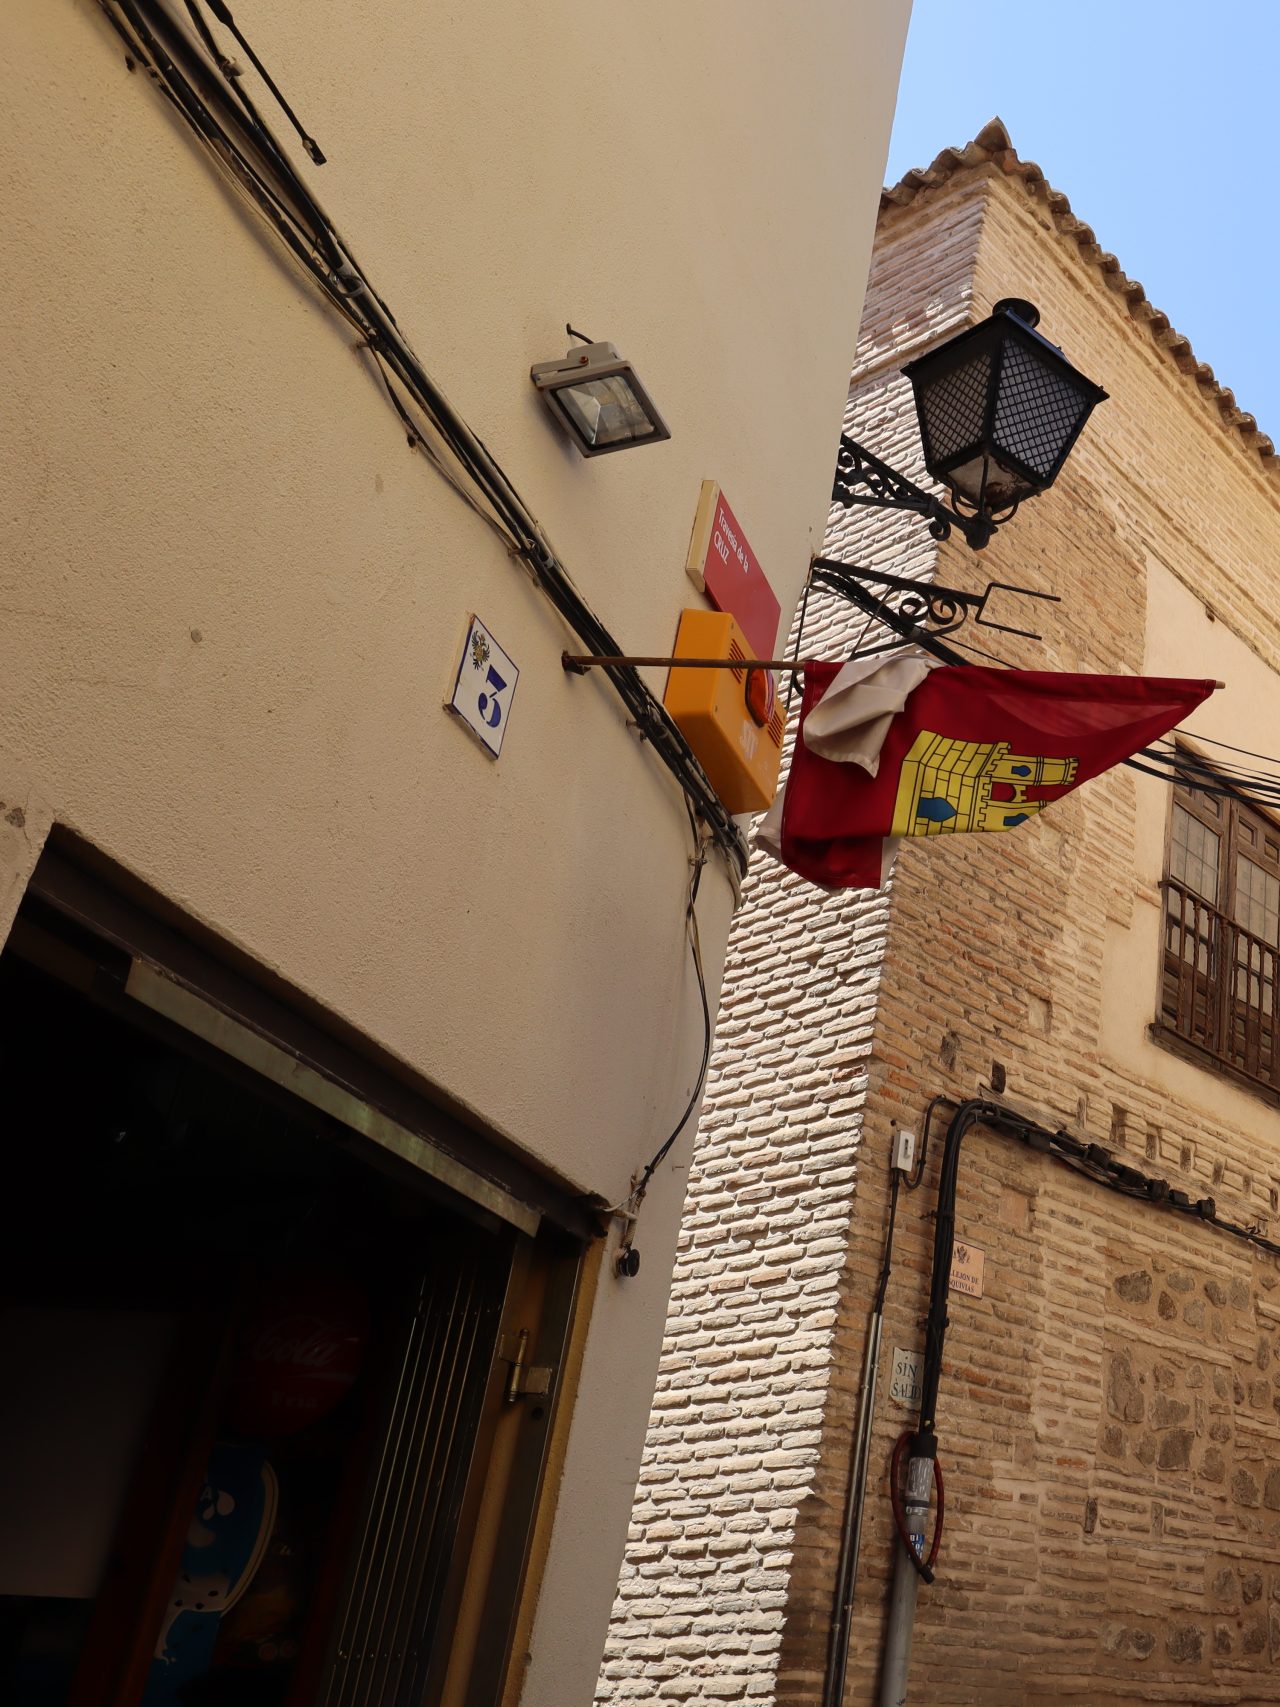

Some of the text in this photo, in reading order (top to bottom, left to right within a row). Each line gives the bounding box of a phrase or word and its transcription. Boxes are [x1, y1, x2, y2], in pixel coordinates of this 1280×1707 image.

[714, 530, 730, 565] CRUZ
[736, 545, 745, 565] de
[743, 555, 750, 574] la
[478, 664, 507, 728] 3
[896, 1362, 918, 1378] SIN
[891, 1381, 921, 1399] SALID
